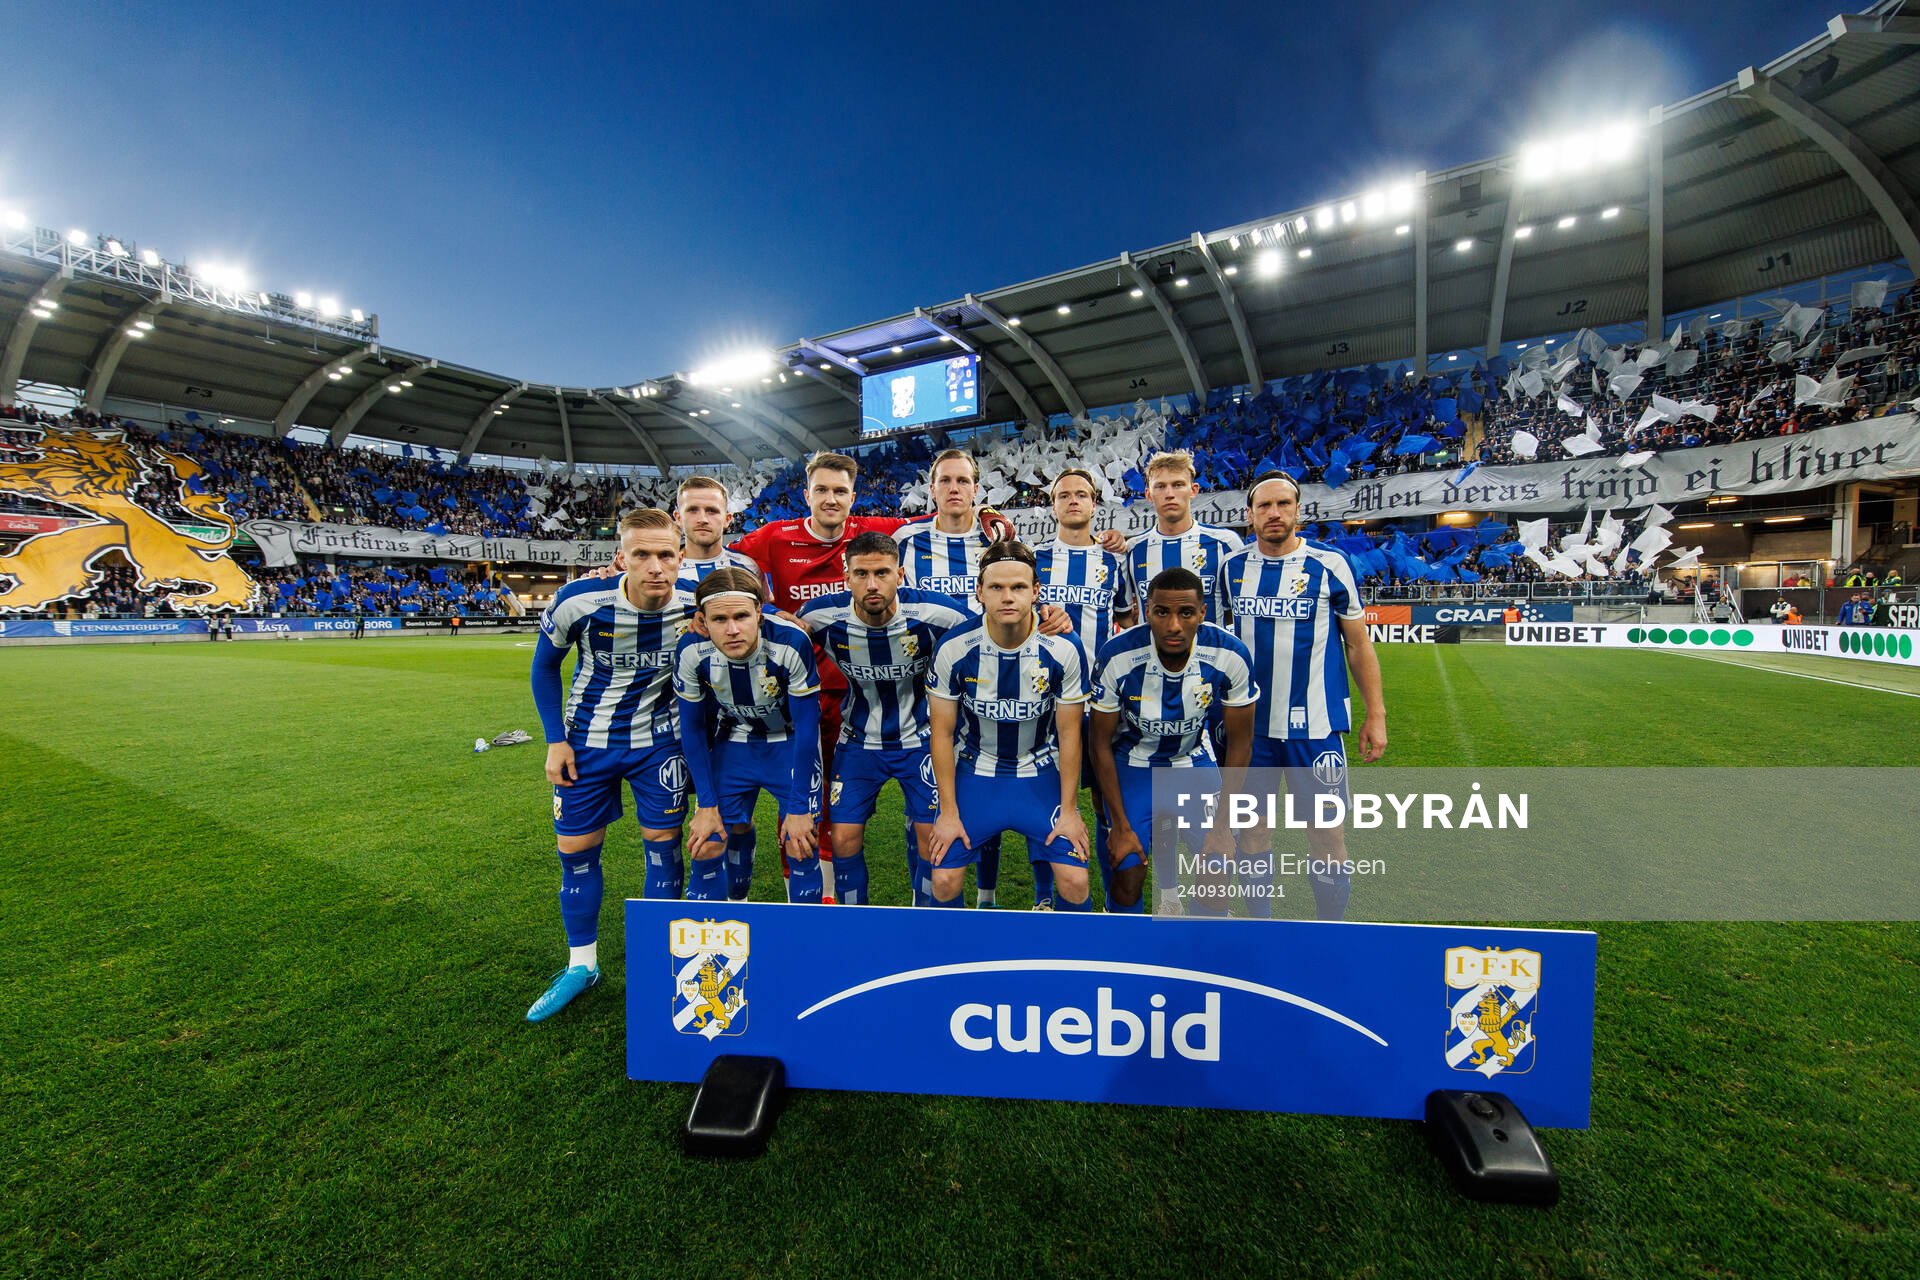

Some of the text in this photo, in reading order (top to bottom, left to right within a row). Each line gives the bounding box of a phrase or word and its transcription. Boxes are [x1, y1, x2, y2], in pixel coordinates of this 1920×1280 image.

[1758, 252, 1791, 272] J1
[1557, 300, 1587, 315] J2
[1327, 342, 1348, 355] J3
[185, 386, 212, 397] F3
[1129, 378, 1148, 389] J4
[399, 425, 418, 433] F2
[1342, 482, 1423, 519] Men
[1441, 478, 1539, 504] deras
[481, 541, 515, 560] lilla
[921, 577, 976, 594] SERNE
[1039, 585, 1108, 607] SERNEKE
[1233, 596, 1309, 618] SERNEKE
[72, 623, 179, 633] STENFASTIGHETER
[256, 623, 290, 632] RASTA
[314, 618, 392, 631] IFK GÖTBORG
[1509, 626, 1607, 643] UNIBET
[1782, 629, 1828, 651] UNIBET
[597, 651, 675, 668] SERNE
[673, 791, 684, 807] 17
[949, 987, 1221, 1062] cuebid
